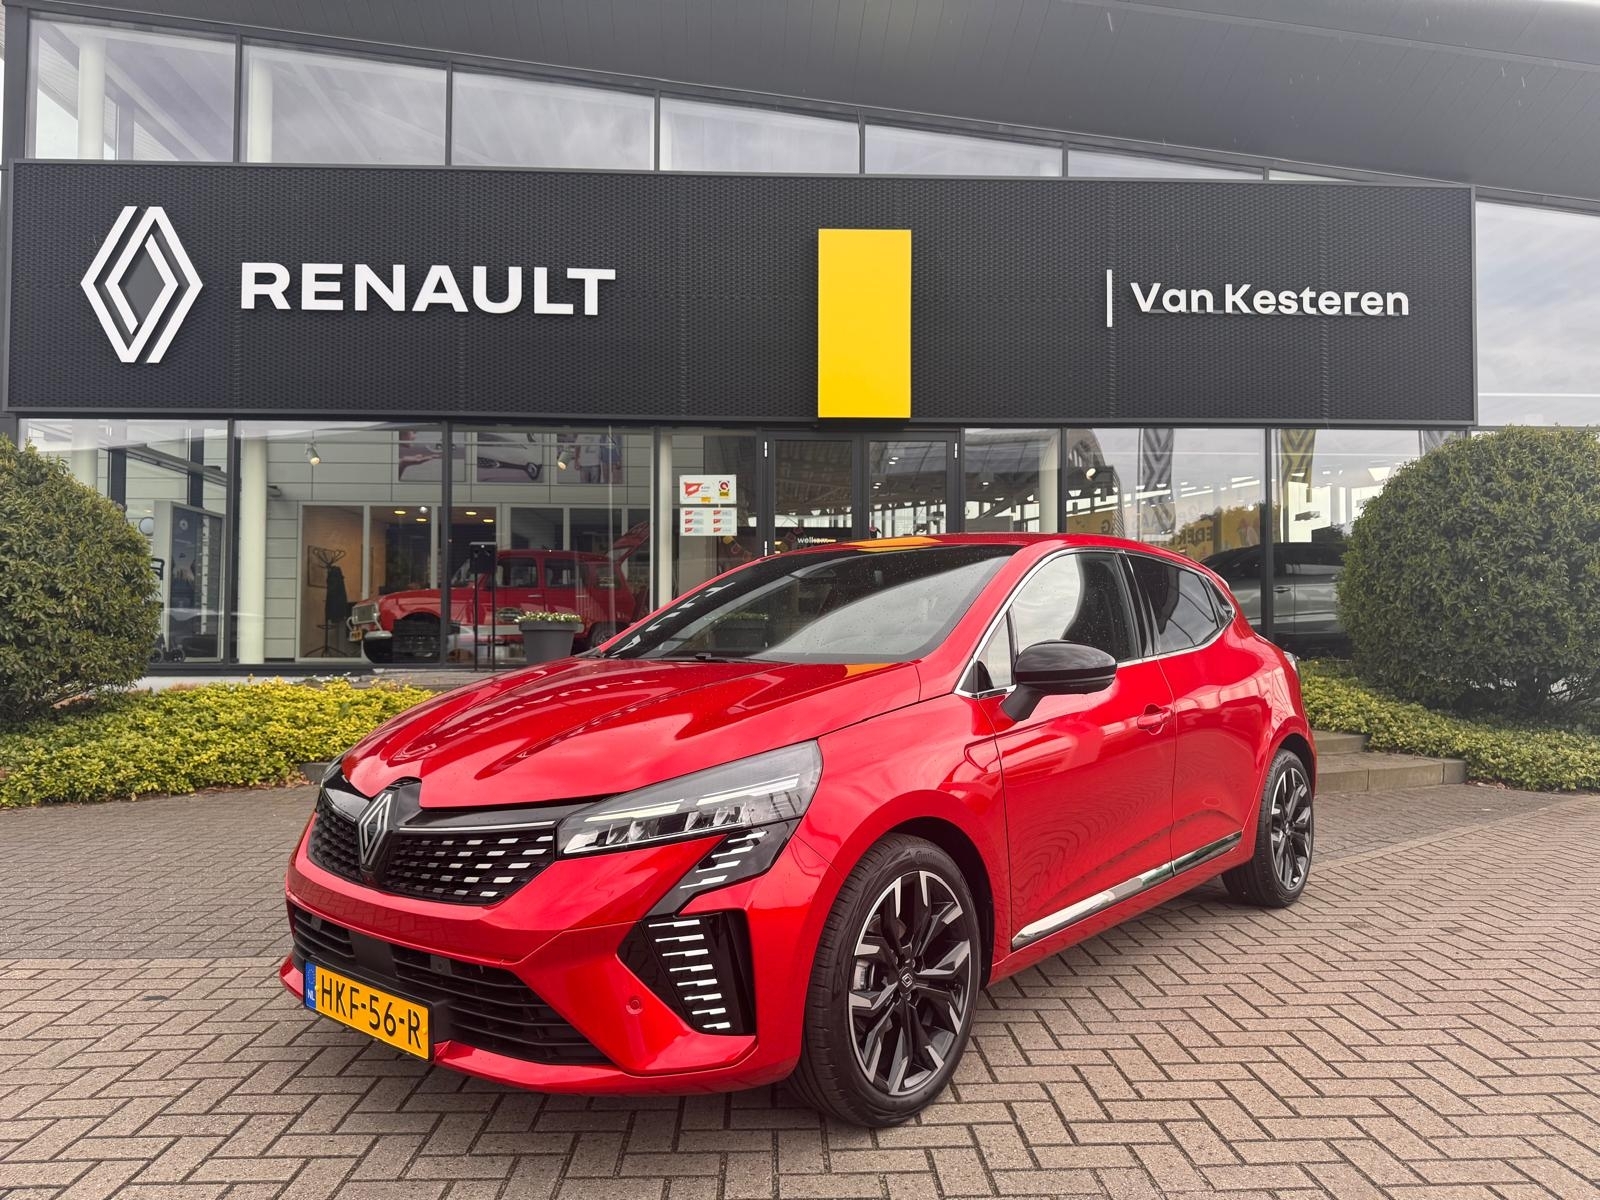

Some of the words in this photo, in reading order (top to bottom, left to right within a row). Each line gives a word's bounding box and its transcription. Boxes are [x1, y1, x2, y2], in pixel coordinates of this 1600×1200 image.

[240, 262, 616, 316] RENAULT
[1130, 282, 1214, 313] Van
[1225, 283, 1409, 316] Kesteren
[307, 989, 315, 1001] NL
[321, 974, 421, 1049] HKF-56-R
